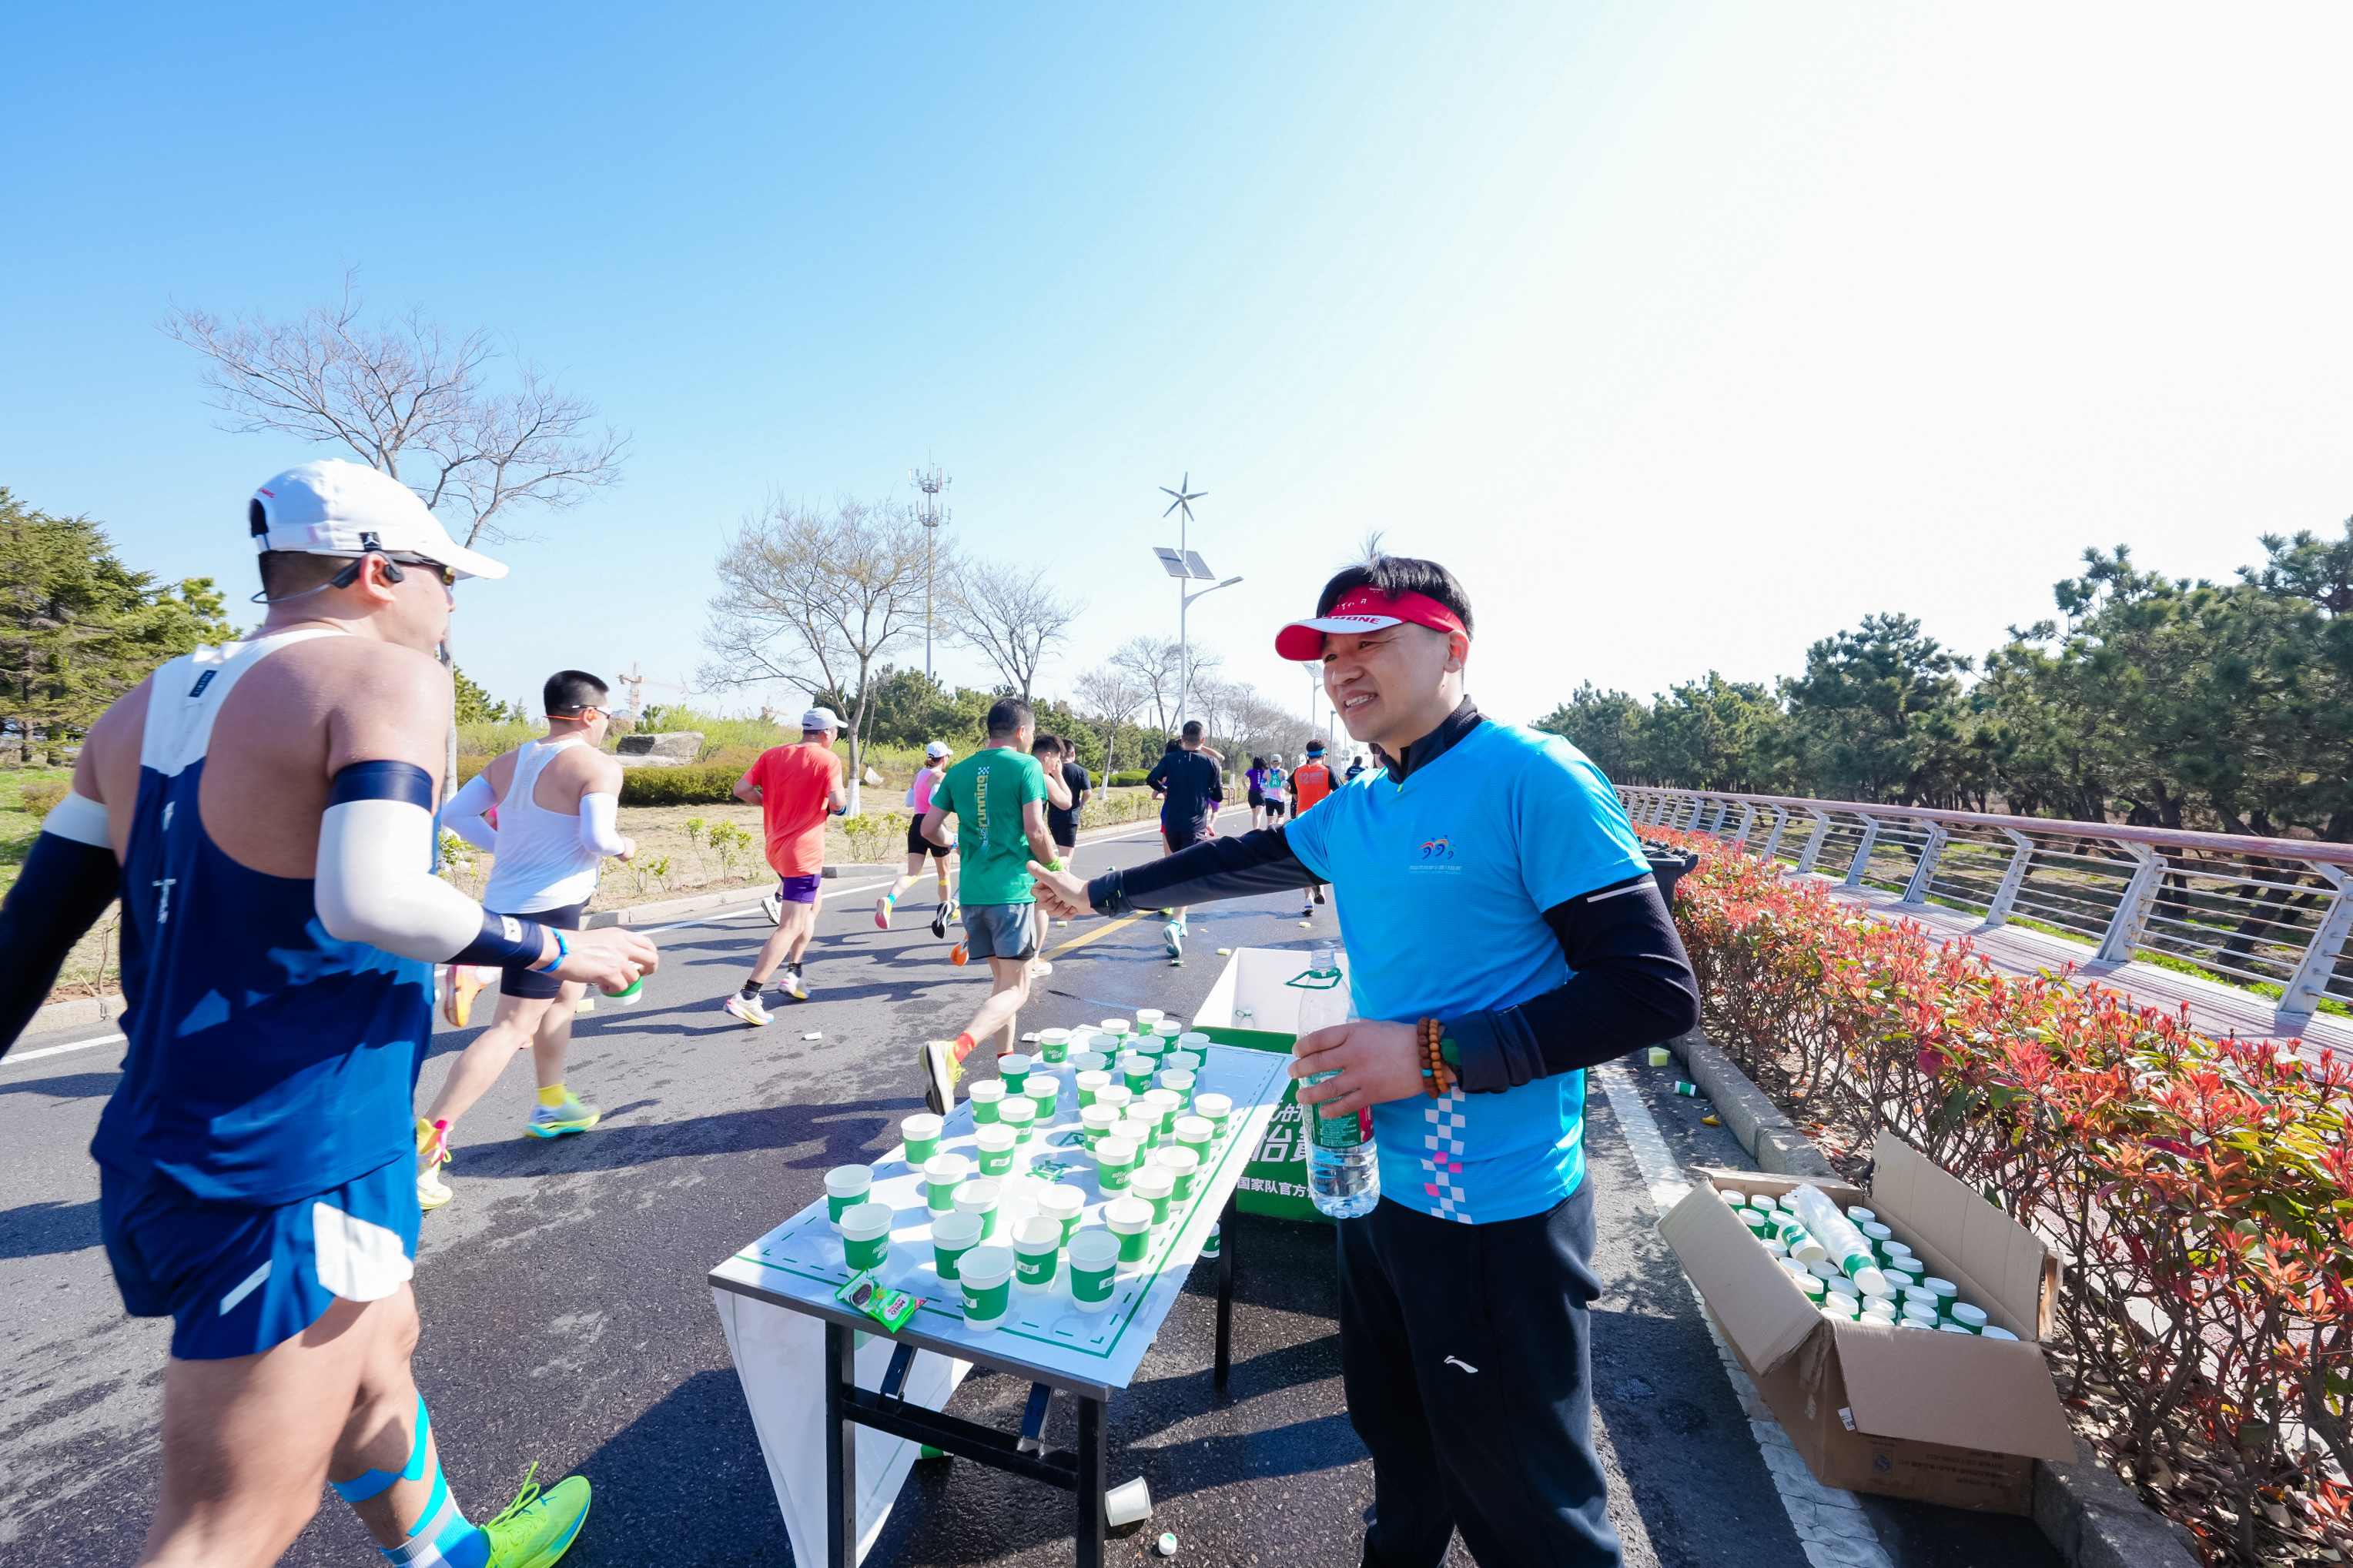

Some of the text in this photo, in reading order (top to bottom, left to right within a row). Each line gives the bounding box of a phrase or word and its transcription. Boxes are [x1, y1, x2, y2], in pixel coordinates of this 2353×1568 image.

[974, 775, 989, 827] running
[1237, 1176, 1313, 1199] 国家队官方
[891, 1299, 905, 1316] MILO
